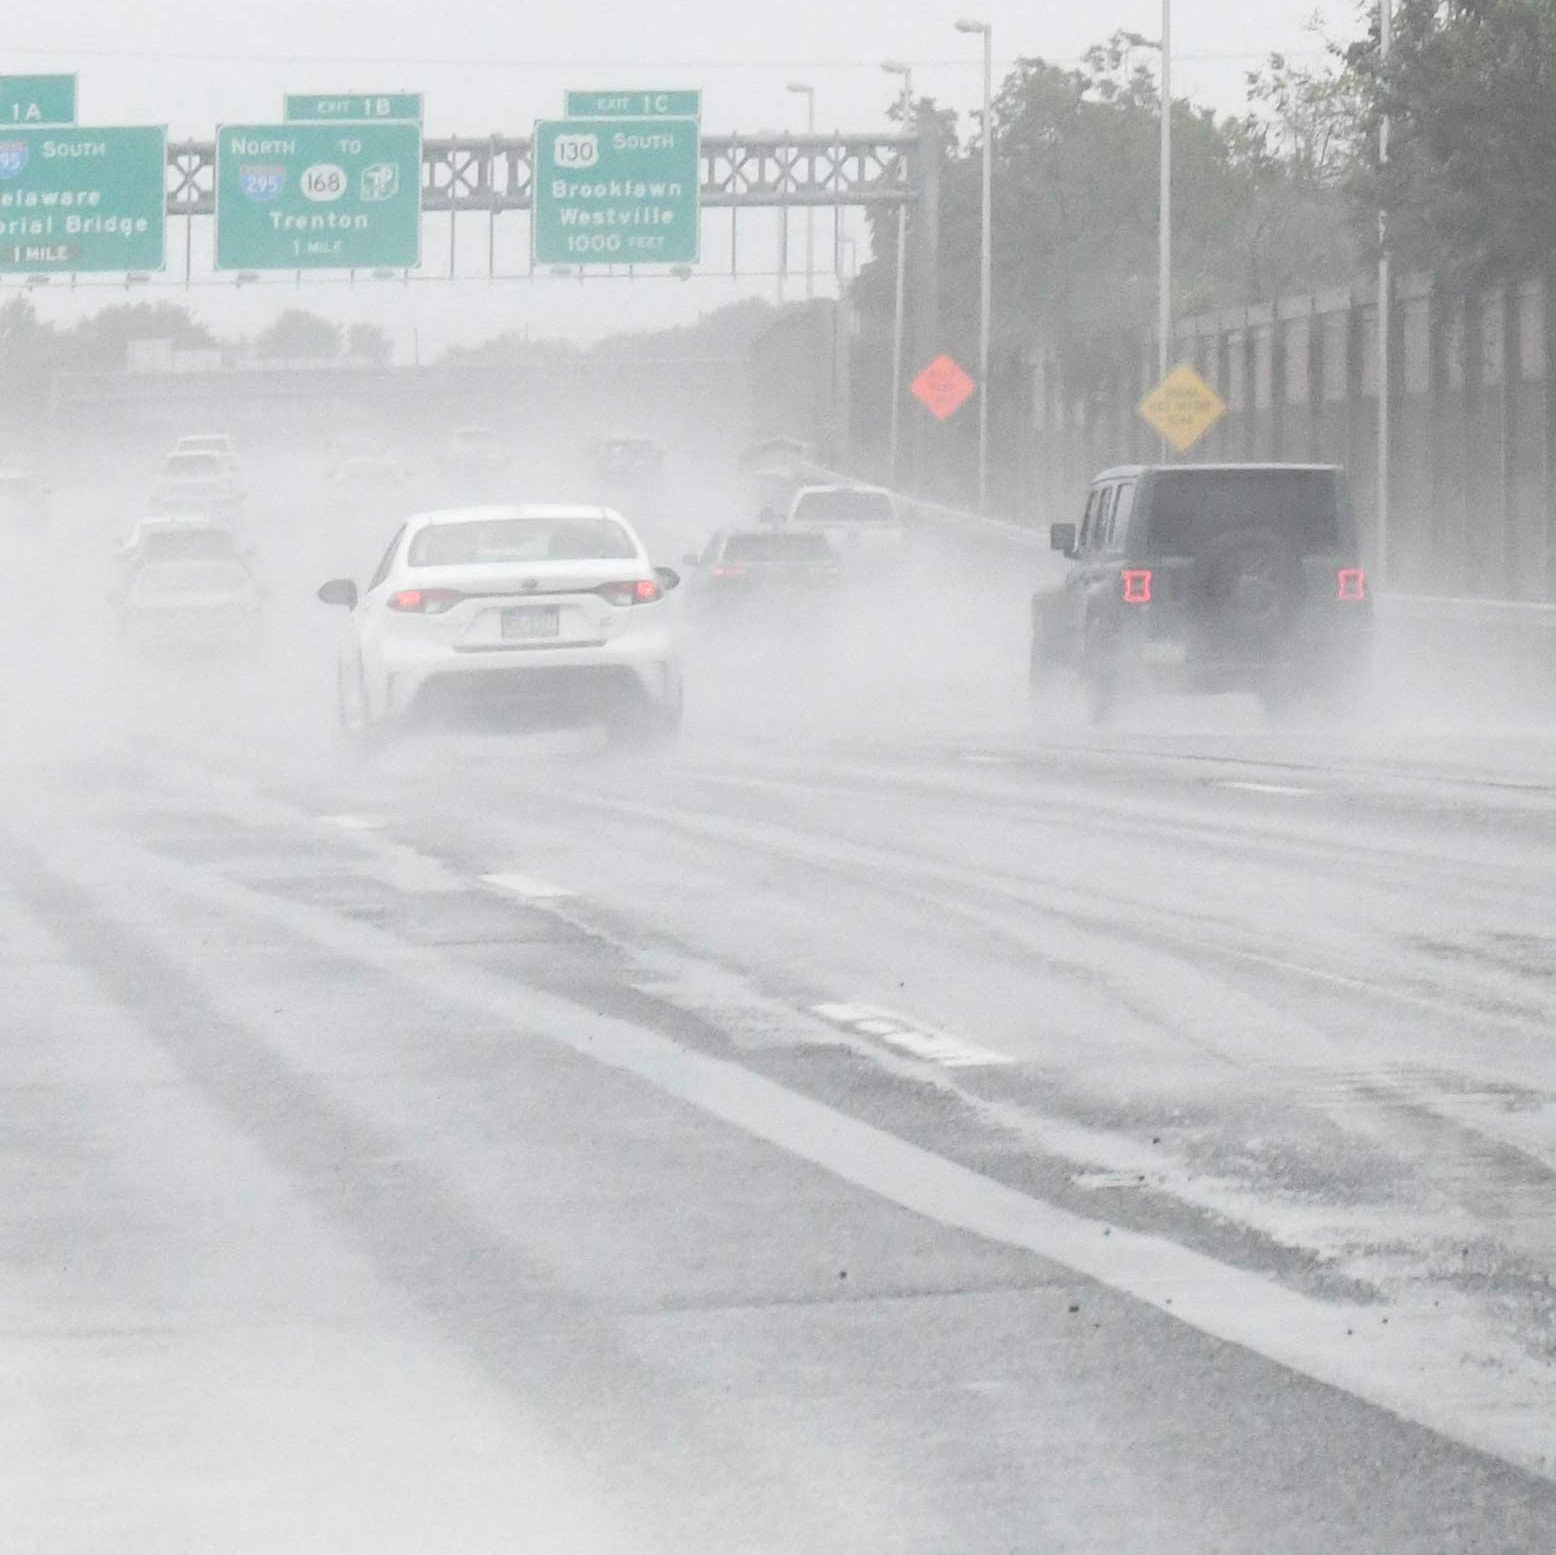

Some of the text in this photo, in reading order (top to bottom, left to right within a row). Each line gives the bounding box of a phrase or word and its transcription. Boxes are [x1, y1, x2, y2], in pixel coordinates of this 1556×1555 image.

[317, 100, 350, 114] EXIT
[597, 97, 629, 110] EXIT
[42, 141, 107, 158] SOUTH
[231, 137, 361, 155] NORTH TO
[559, 133, 675, 161] 130 SOUTH
[246, 175, 280, 194] 295
[306, 172, 341, 193] 168
[552, 180, 682, 198] Brooklawn
[0, 189, 101, 207] elaware
[269, 211, 369, 229] Trenton
[560, 207, 675, 225] Westville
[65, 214, 149, 237] Bridge
[568, 235, 621, 252] 1000
[26, 245, 70, 261] MILE
